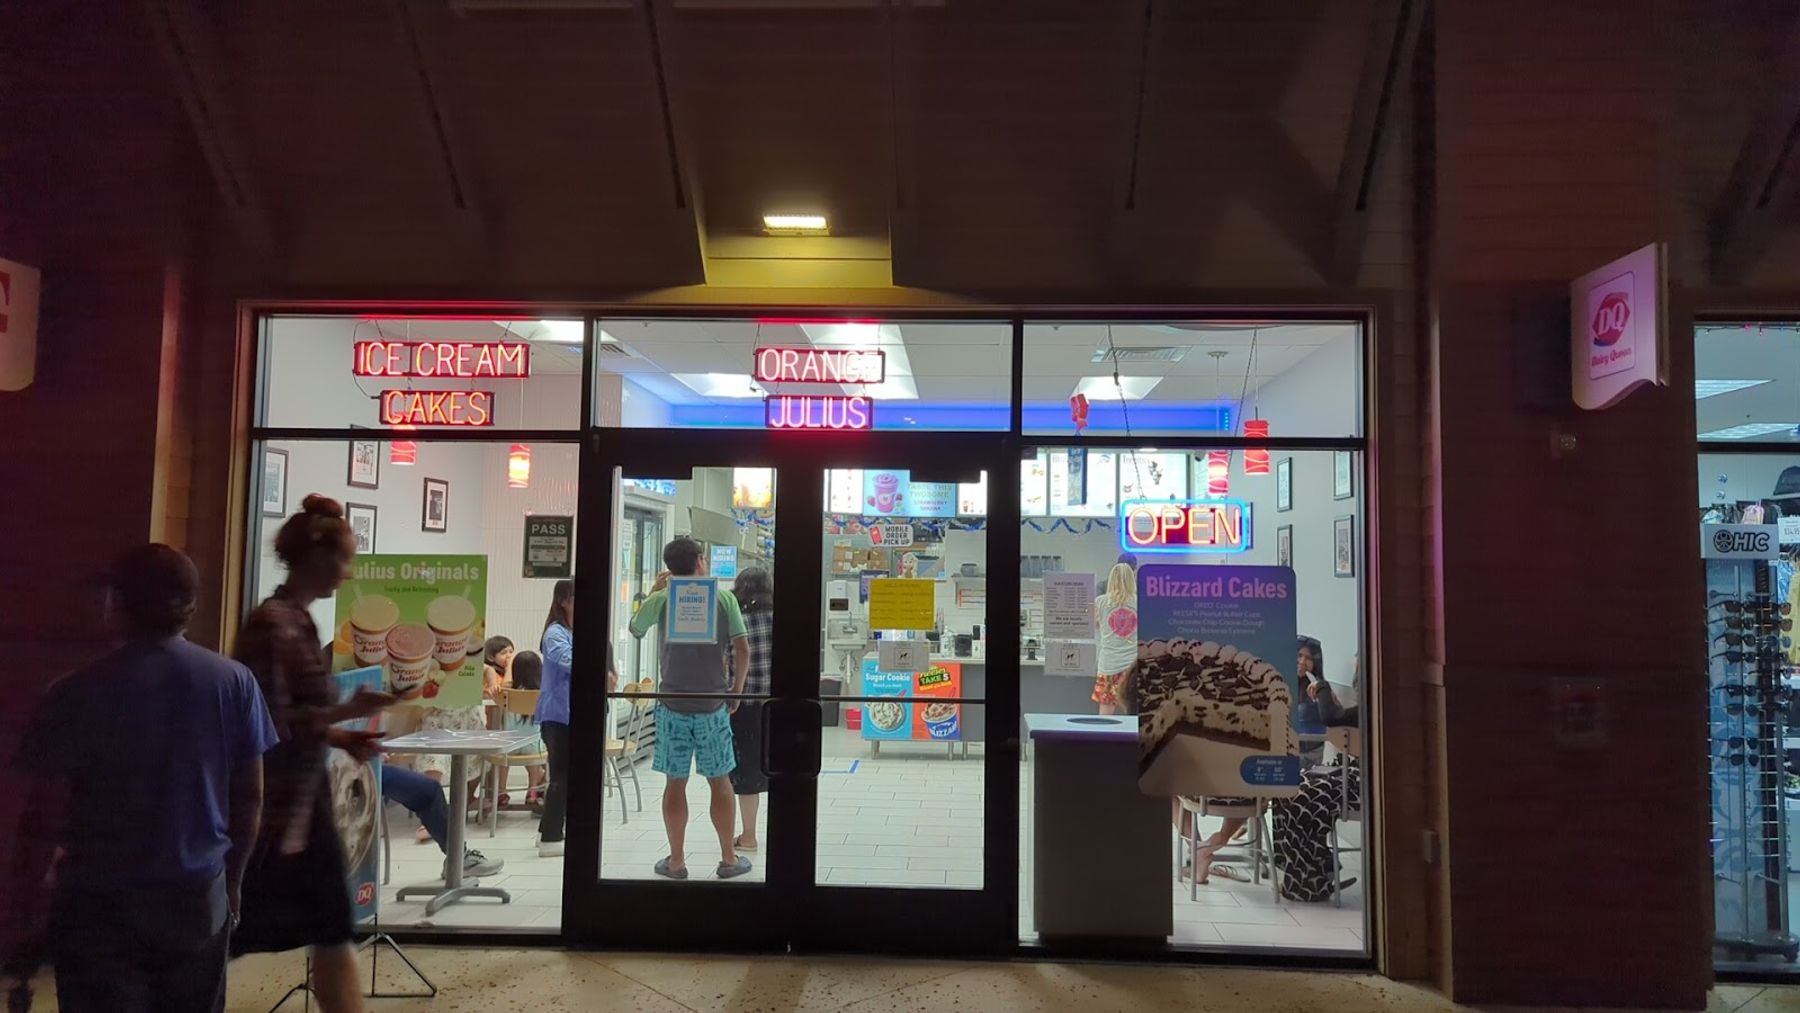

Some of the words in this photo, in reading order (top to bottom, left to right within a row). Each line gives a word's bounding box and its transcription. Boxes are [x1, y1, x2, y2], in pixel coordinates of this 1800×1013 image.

[1599, 302, 1626, 335] DQ
[360, 342, 404, 376] ICE
[415, 342, 524, 377] CREAM
[1592, 355, 1609, 366] Dairy
[1609, 347, 1632, 362] Queen
[386, 390, 488, 425] CAKES
[771, 396, 867, 429] JULIUS
[531, 523, 566, 535] PASS
[1127, 506, 1241, 545] OPEN
[1733, 531, 1770, 552] HIC
[353, 561, 396, 580] ulius
[400, 561, 480, 585] Originals
[1146, 575, 1223, 597] Blizzard
[1228, 576, 1287, 598] Cakes
[865, 673, 886, 683] Sugar
[887, 673, 910, 681] Cookie
[921, 675, 942, 685] TAKE
[357, 887, 373, 901] DQ
